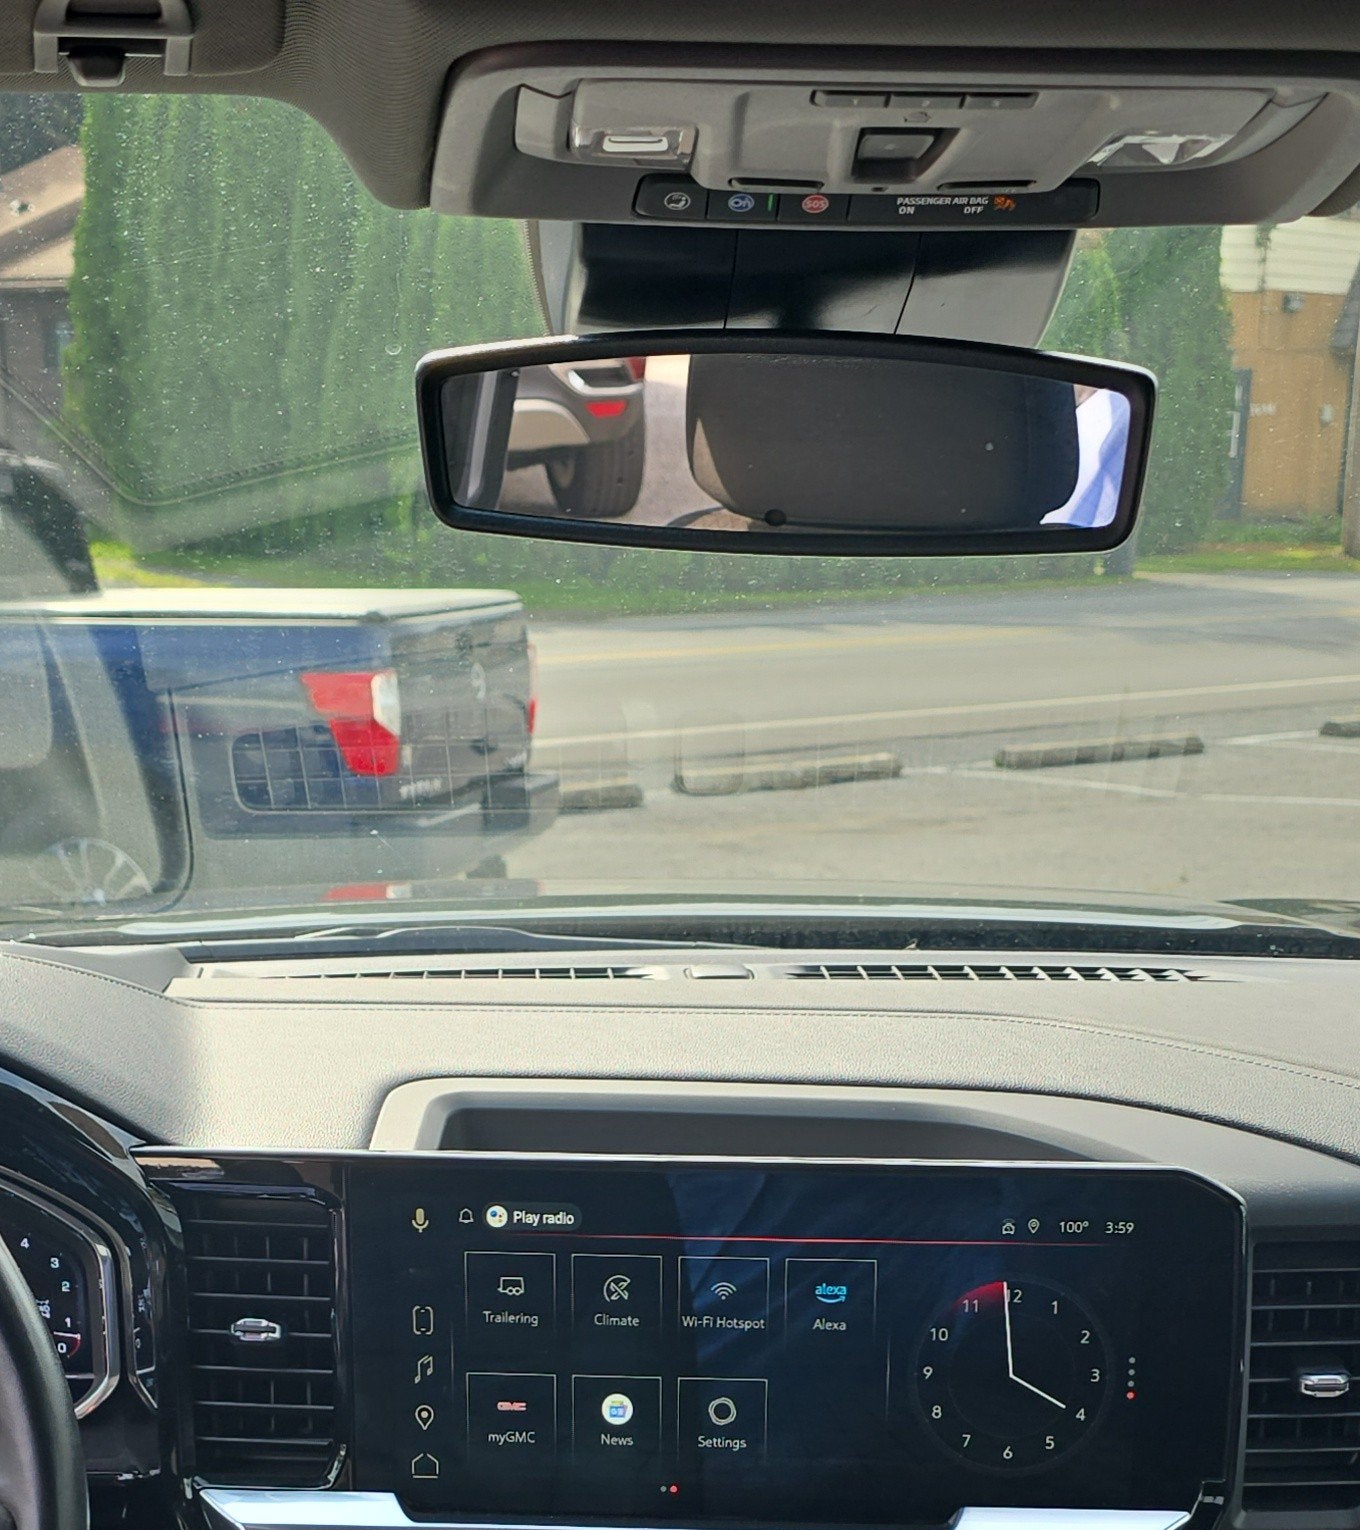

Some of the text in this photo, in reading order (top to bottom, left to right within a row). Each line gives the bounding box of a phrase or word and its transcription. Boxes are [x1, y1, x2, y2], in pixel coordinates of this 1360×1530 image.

[804, 199, 828, 209] SOS
[897, 196, 989, 206] PASSENGER AIR BAG
[898, 206, 985, 216] ON OFF
[512, 1210, 576, 1227] Play radio
[1105, 1220, 1135, 1236] 3:59
[20, 1237, 30, 1249] 4
[50, 1257, 60, 1269] 3
[61, 1281, 71, 1292] 2
[814, 1282, 848, 1297] alexa
[1007, 1289, 1023, 1304] 12
[962, 1298, 981, 1314] 11
[1051, 1300, 1060, 1315] 1
[64, 1317, 72, 1328] 1
[483, 1310, 540, 1328] Trailering
[593, 1313, 641, 1328] Climate
[681, 1315, 766, 1333] Wi-Fi Hotspot
[812, 1317, 848, 1332] Alexa
[929, 1326, 950, 1342] 10
[1080, 1329, 1091, 1344] 2
[922, 1364, 933, 1380] 9
[1090, 1367, 1101, 1383] 3
[931, 1405, 942, 1420] 8
[1075, 1407, 1087, 1422] 4
[488, 1431, 536, 1446] myGMC
[601, 1433, 634, 1447] News
[697, 1435, 748, 1452] Settings
[961, 1434, 972, 1449] 7
[1045, 1435, 1056, 1451] 5
[1002, 1444, 1014, 1460] 6
